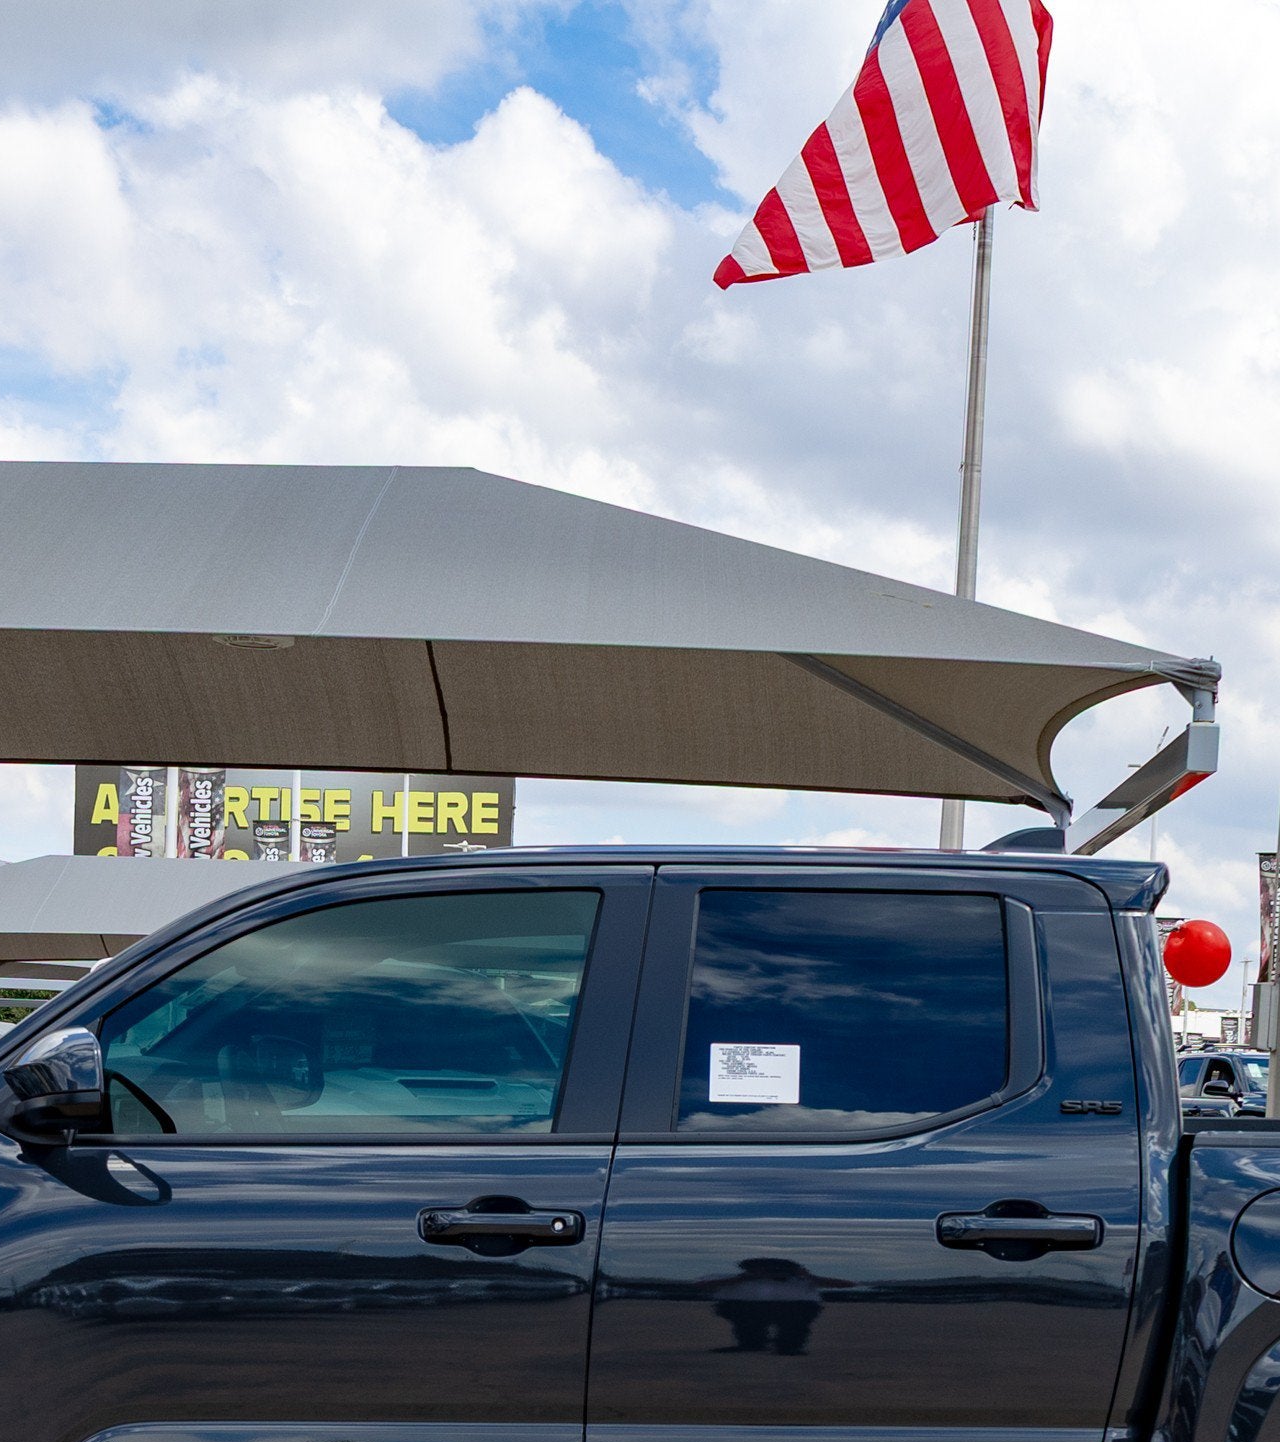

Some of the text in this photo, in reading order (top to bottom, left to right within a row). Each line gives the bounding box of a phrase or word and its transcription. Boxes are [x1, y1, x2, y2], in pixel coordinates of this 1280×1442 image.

[91, 783, 499, 834] ARTISE HERE
[131, 777, 153, 845] Vehicles
[189, 780, 212, 854] Vehicles
[1061, 1100, 1122, 1113] SR5
